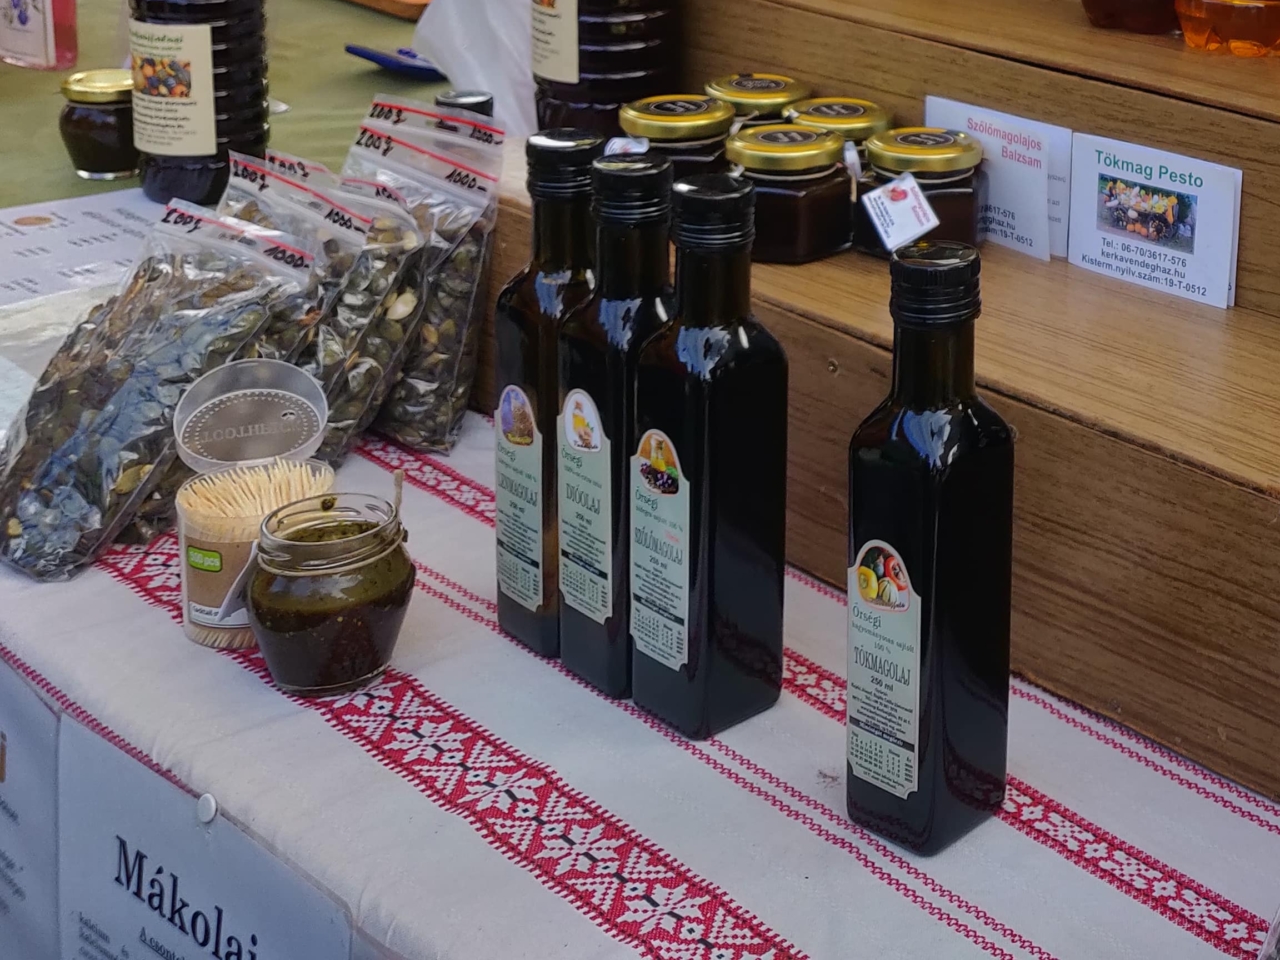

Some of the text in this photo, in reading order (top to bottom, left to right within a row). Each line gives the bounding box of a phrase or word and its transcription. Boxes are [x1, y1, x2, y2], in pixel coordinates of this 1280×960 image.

[1001, 145, 1042, 170] Balzsam
[1095, 149, 1204, 188] Tökmag Pesto
[1101, 236, 1187, 268] Tel.: 06-70/3617-576
[1101, 247, 1186, 280] kerkavendeghaz.hu
[1081, 253, 1207, 297] Kisterm.nyilv.szám:19-T-0512
